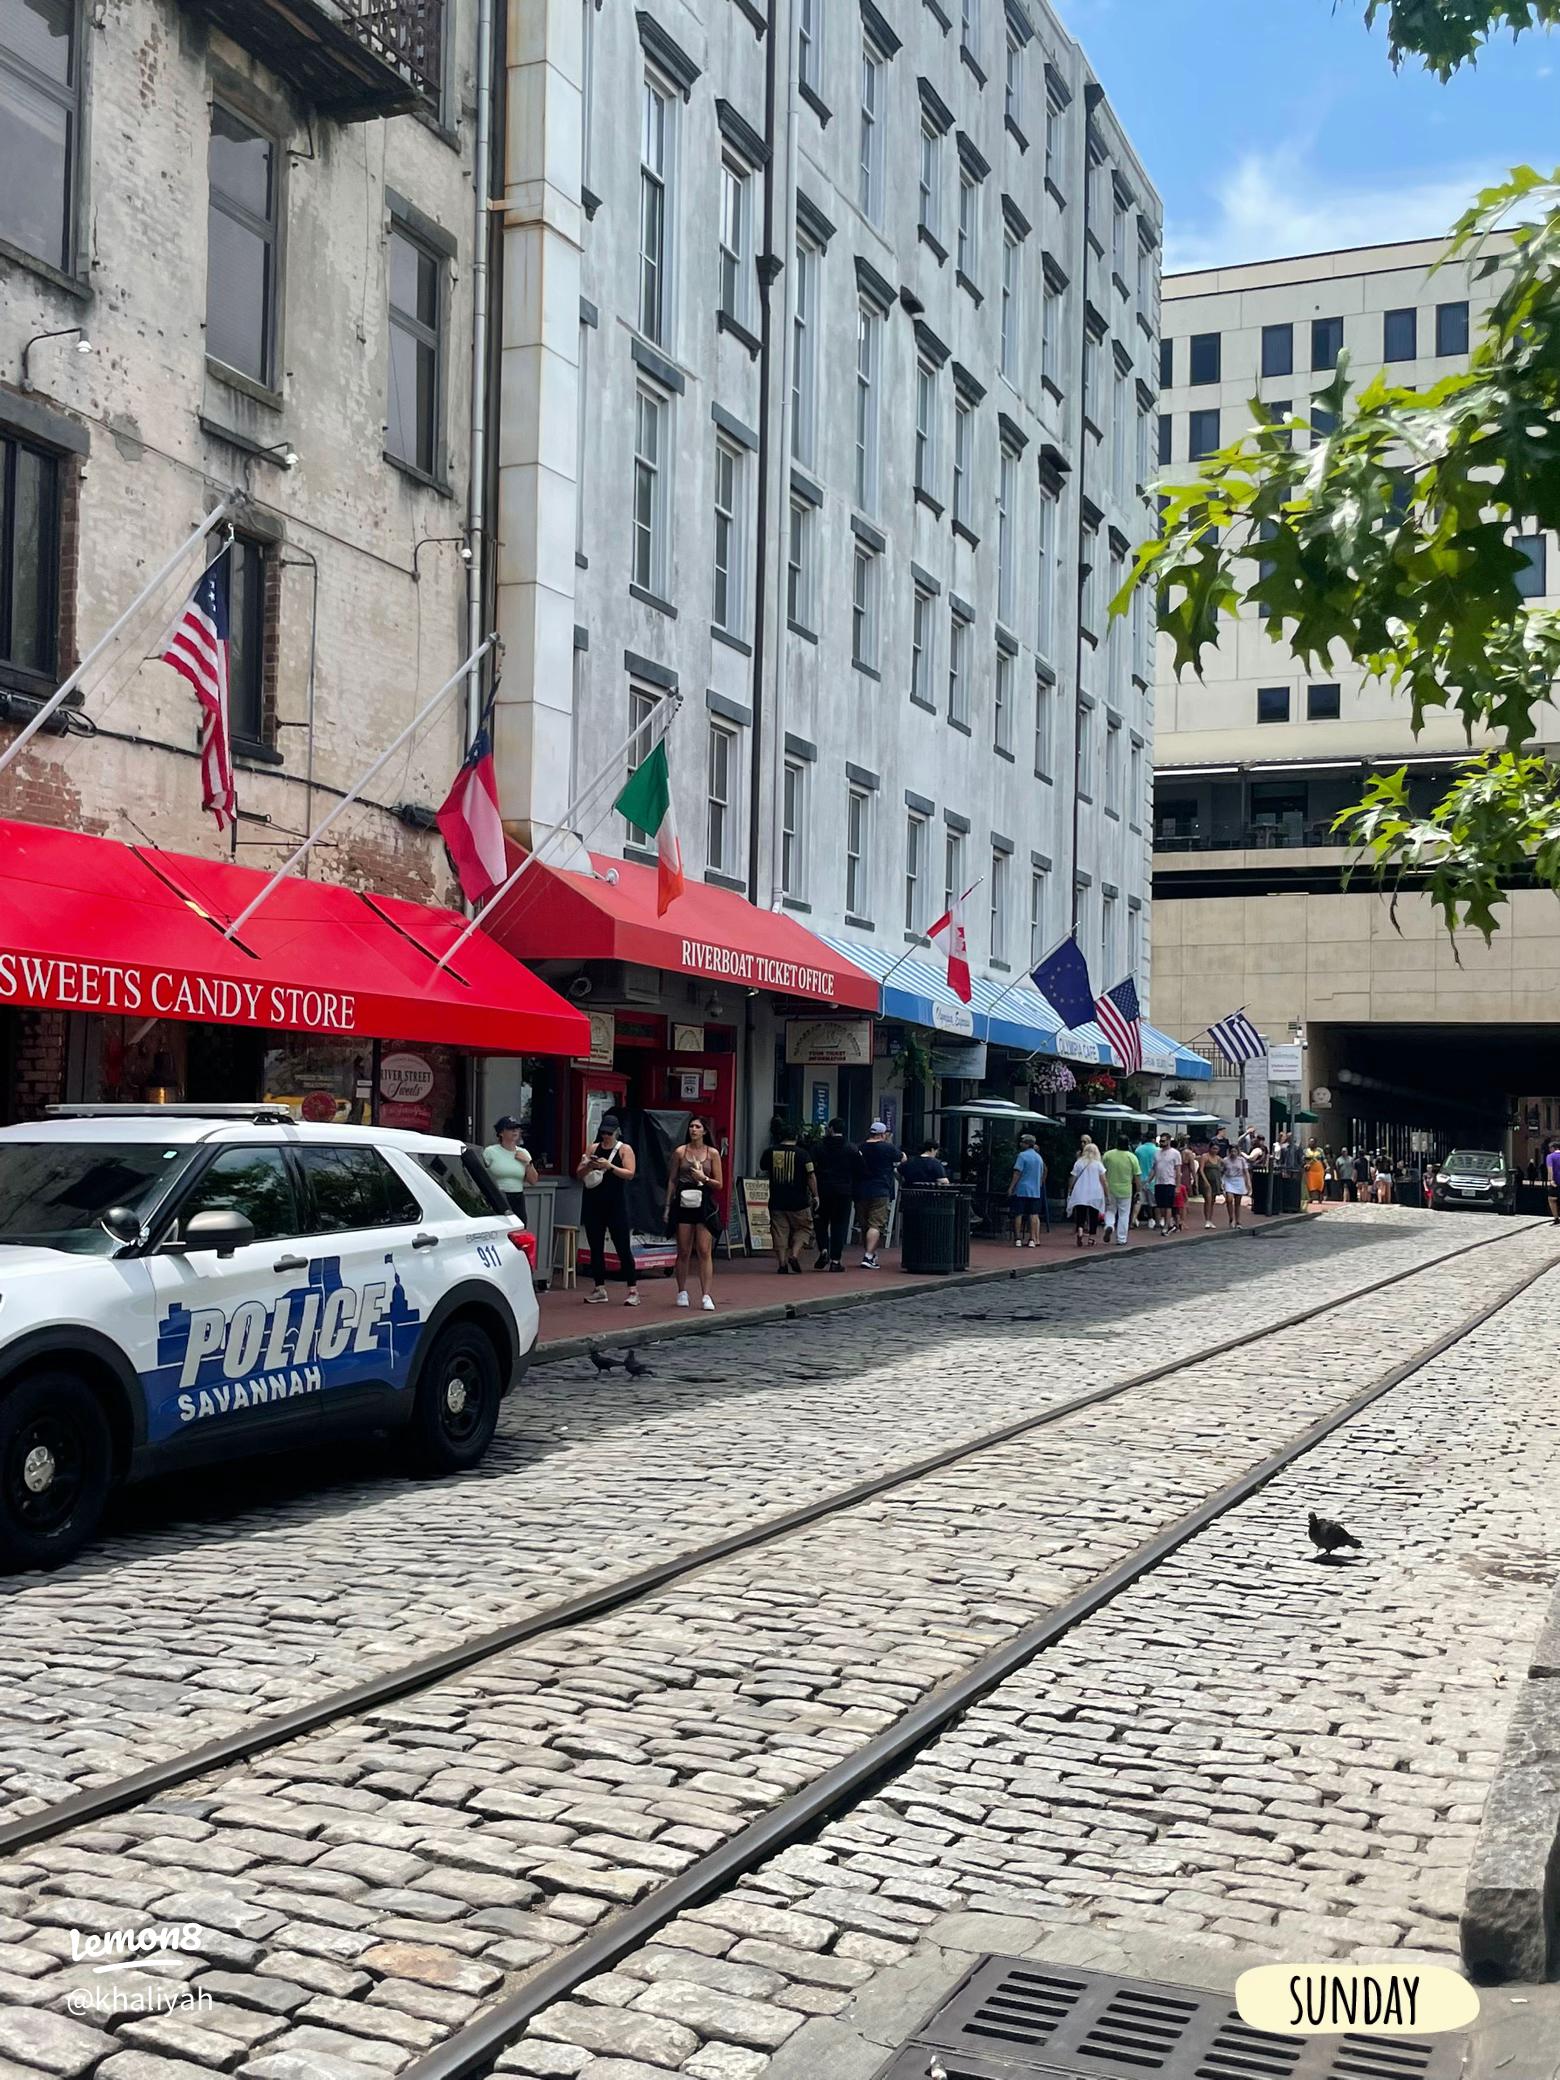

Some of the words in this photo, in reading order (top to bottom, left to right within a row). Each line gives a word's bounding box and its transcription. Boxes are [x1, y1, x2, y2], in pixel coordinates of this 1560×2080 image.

[0, 953, 142, 1009] SWEETS
[151, 973, 264, 1019] CANDY
[270, 986, 356, 1030] STORE
[682, 940, 754, 978] RIVERBOAT
[756, 957, 798, 987] TICKET
[798, 967, 834, 996] OFFICE
[388, 1081, 423, 1098] Sweets
[404, 1070, 431, 1083] STREET
[477, 1245, 502, 1268] 911
[179, 1282, 386, 1388] POLICE
[178, 1366, 321, 1421] SAVANNAH
